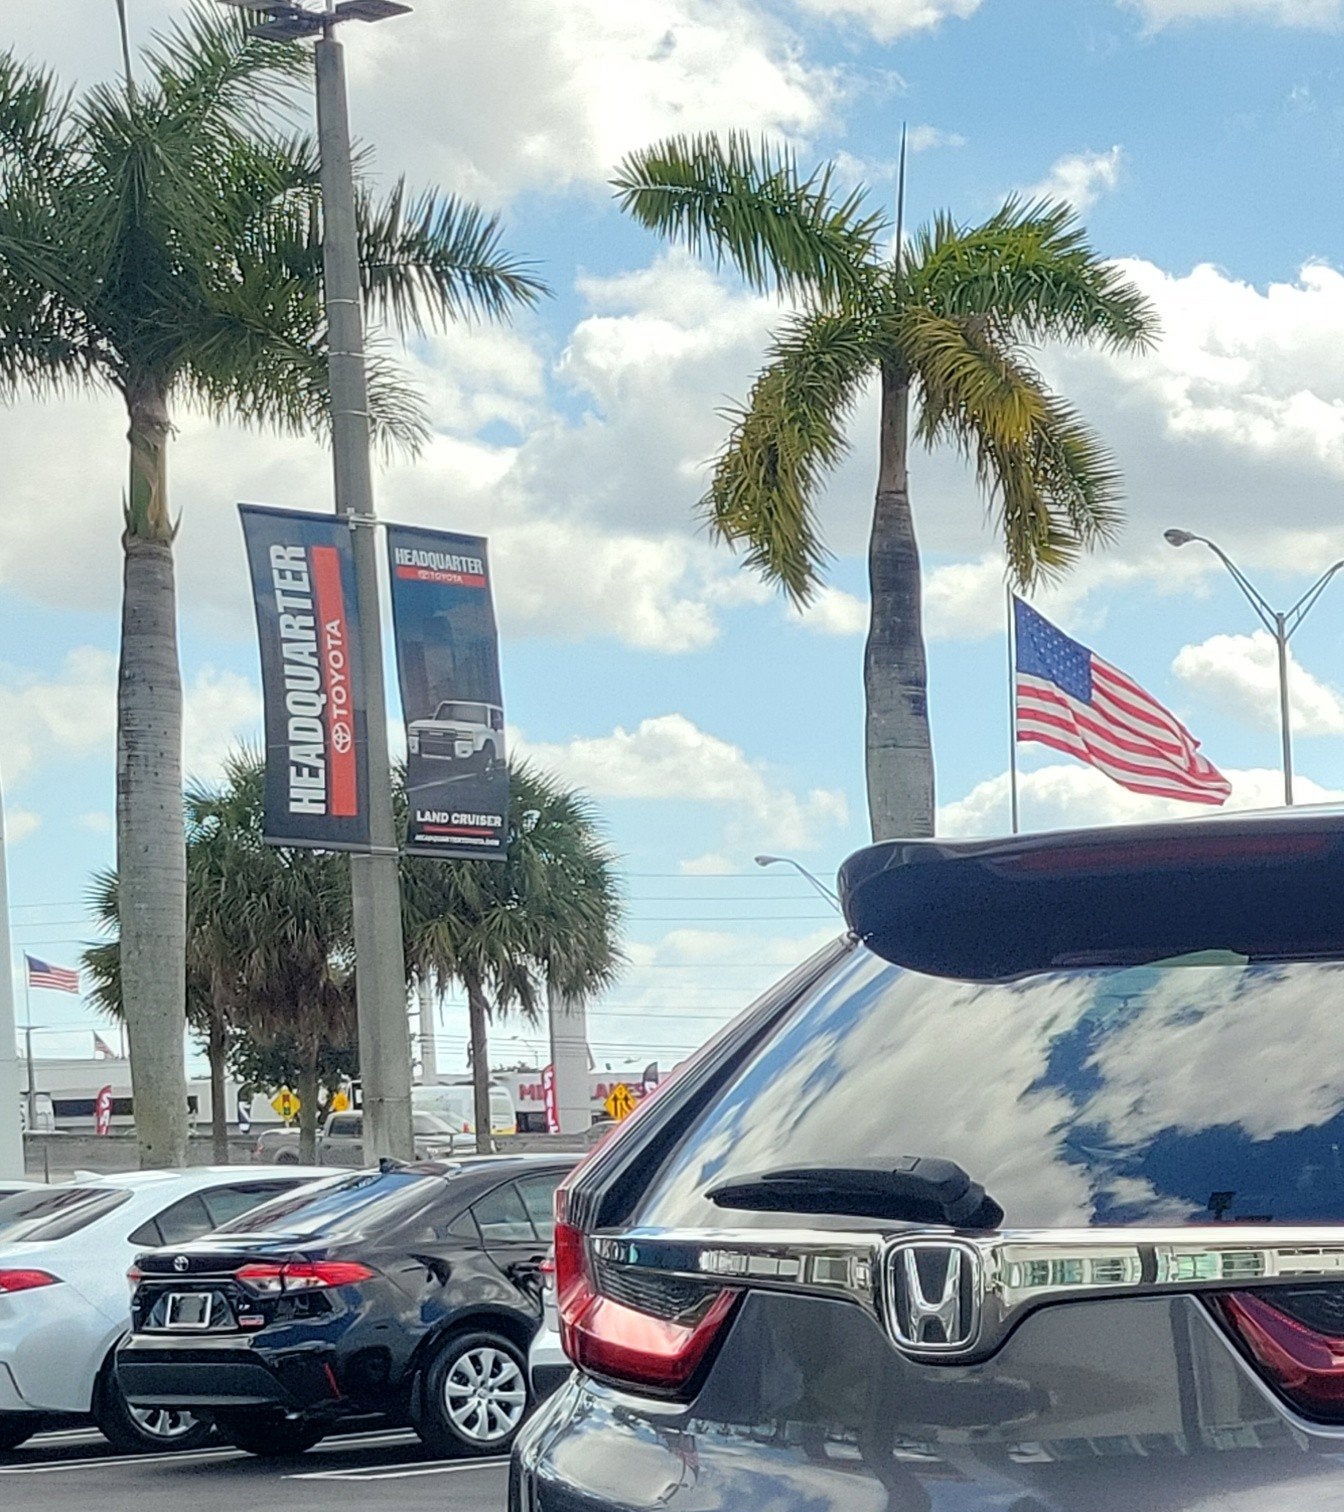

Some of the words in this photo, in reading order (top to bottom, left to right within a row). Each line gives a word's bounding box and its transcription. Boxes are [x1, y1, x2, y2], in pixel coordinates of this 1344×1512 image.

[394, 547, 484, 575] HEADQUARTER
[269, 543, 326, 815] HEADQUARTER
[326, 619, 349, 718] TOYOTA
[416, 810, 449, 824] LAND
[451, 813, 502, 827] CRUISER
